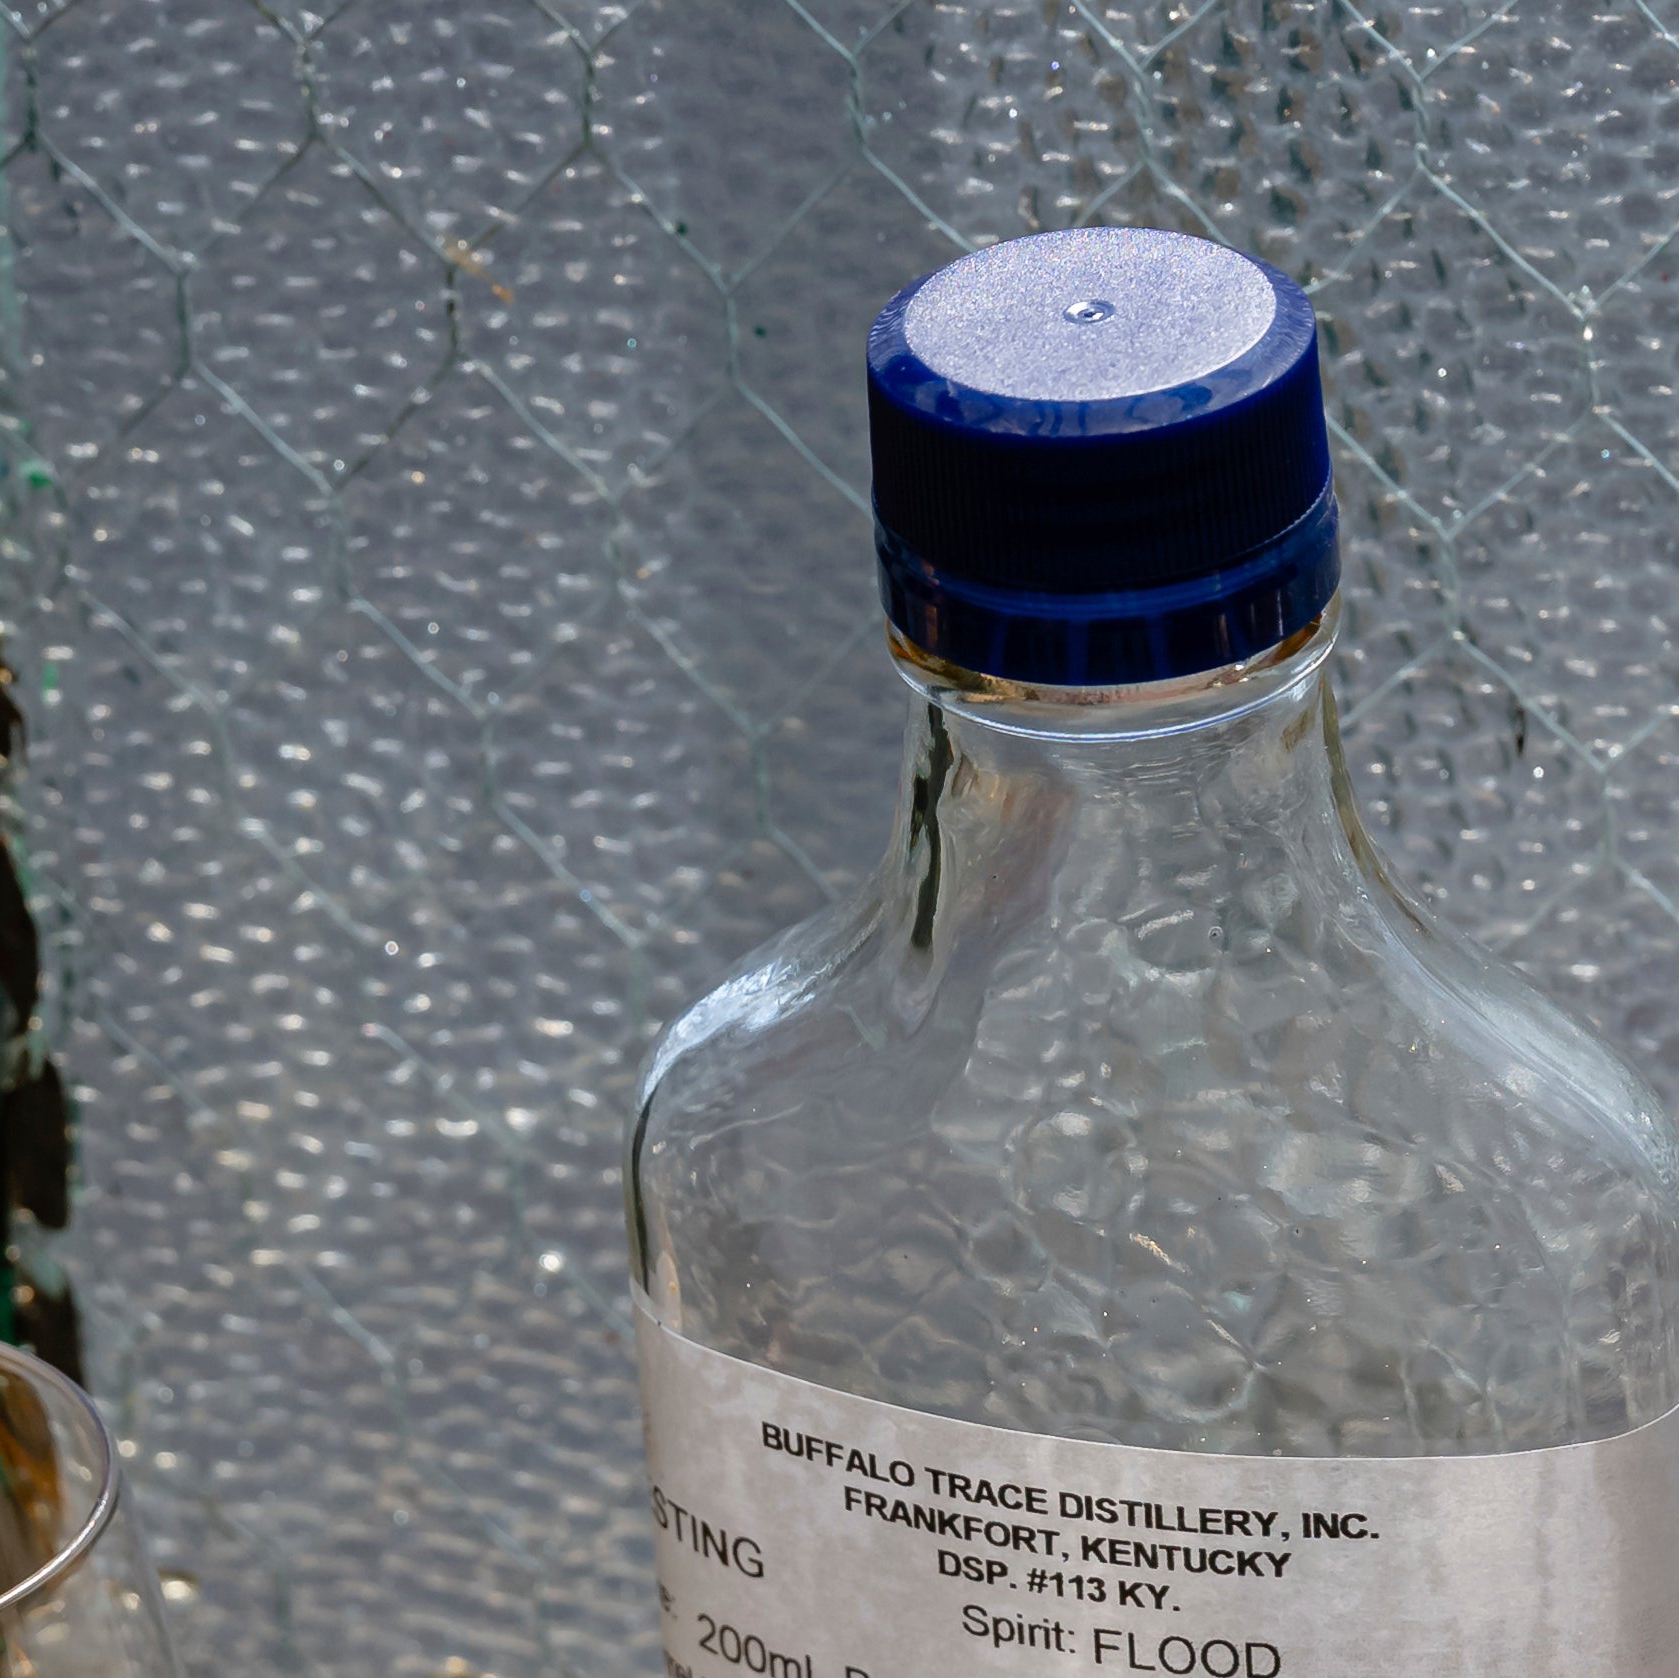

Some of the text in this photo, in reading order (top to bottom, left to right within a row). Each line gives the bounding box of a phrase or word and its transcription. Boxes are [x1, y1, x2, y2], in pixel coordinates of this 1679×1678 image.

[761, 1421, 1379, 1541] BUFFALO TRACE DISTILLERY, INC.
[844, 1485, 1292, 1578] FRANKFORT, KENTUCKY
[937, 1549, 1181, 1611] DSP. #113 KY.
[961, 1604, 1076, 1654] Spirit:
